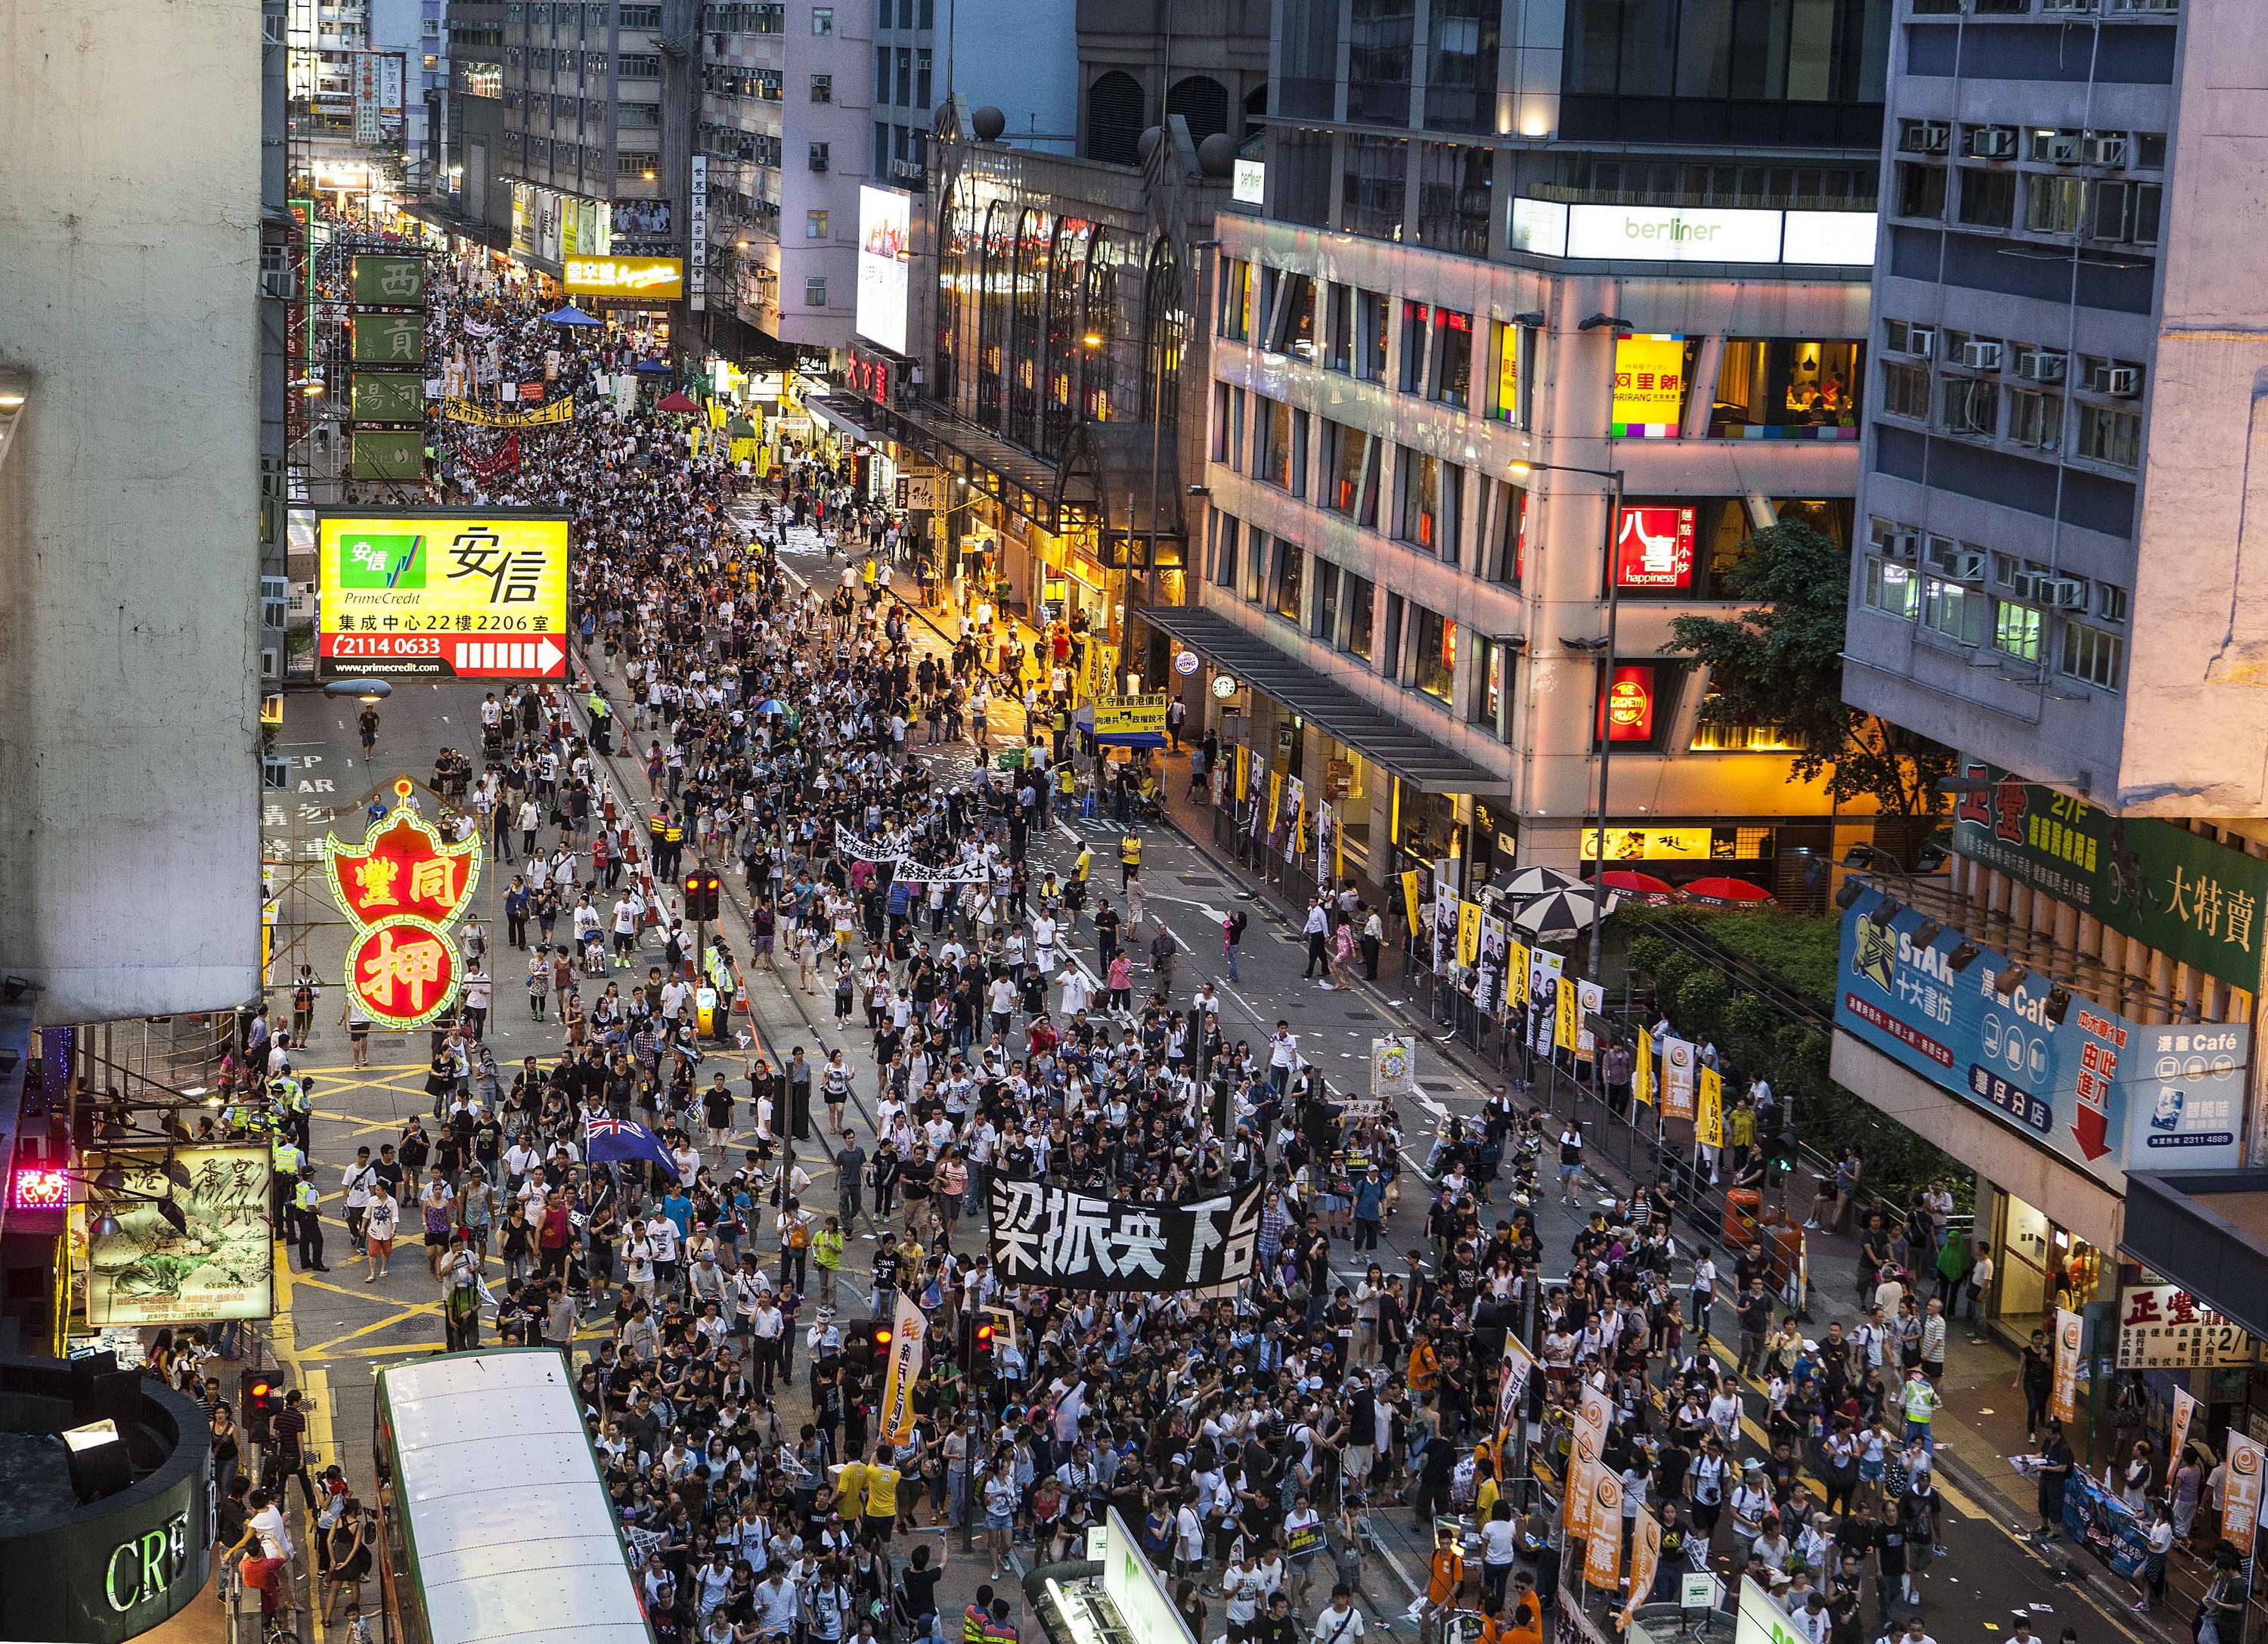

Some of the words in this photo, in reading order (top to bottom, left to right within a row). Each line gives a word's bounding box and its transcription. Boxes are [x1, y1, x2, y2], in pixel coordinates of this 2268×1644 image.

[1240, 169, 1262, 188] berliner
[692, 167, 703, 279] 世界至德宗親總會
[1625, 217, 1721, 240] berliner
[1614, 373, 1678, 391] 阿里朗
[1613, 392, 1651, 402] ARIRANG
[445, 399, 572, 426] 城市規劃民主化
[899, 499, 906, 507] P
[1619, 510, 1677, 572] 八喜
[351, 542, 389, 572] 安信
[446, 526, 547, 604] 安信
[1625, 565, 1675, 585] happiness
[345, 592, 420, 604] PrimeCredit
[339, 614, 549, 631] 集成中心22樓2206室
[345, 638, 390, 654] 2114
[395, 637, 441, 654] 0633
[335, 662, 439, 675] www.primecredit.com
[1106, 696, 1164, 707] 守護香港價值
[1616, 684, 1635, 695] THE
[1095, 715, 1120, 724] 向港共
[1132, 715, 1164, 724] 政權說不
[1613, 709, 1639, 721] HOUSE
[2050, 790, 2090, 824] 2/F
[2164, 864, 2255, 953] 大特賣
[359, 930, 443, 1012] 押
[1895, 971, 1953, 1025] 十大書坊
[2077, 1010, 2129, 1050] 本大廈1樓
[2157, 1035, 2190, 1052] 漫畫
[2192, 1033, 2238, 1052] Café
[2080, 1041, 2118, 1081] 由此
[1975, 1067, 2044, 1128] 灣仔分店
[2074, 1069, 2109, 1111] 進入
[1709, 1097, 1719, 1143] 人民力量
[2121, 1328, 2132, 1367] 各式輪椅
[2204, 1328, 2216, 1366] 老人用品
[2218, 1327, 2258, 1354] 2/F
[2226, 1476, 2256, 1534] 工黨
[1591, 1512, 1619, 1572] 工黨
